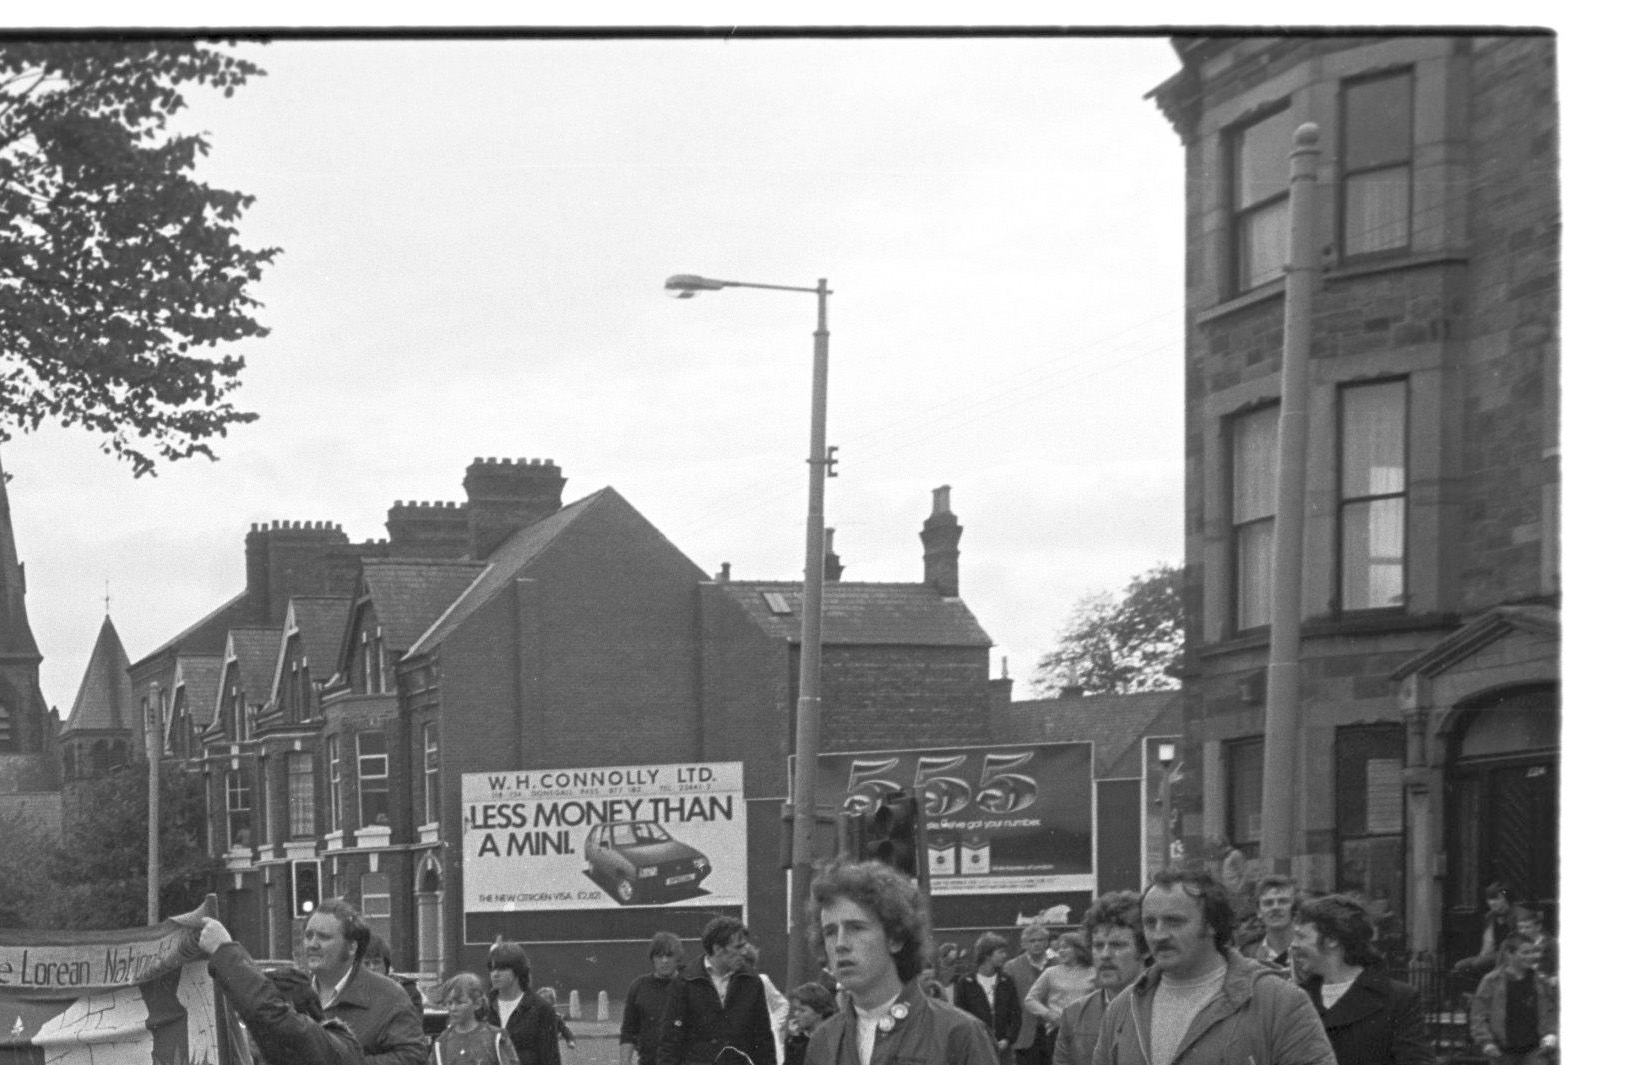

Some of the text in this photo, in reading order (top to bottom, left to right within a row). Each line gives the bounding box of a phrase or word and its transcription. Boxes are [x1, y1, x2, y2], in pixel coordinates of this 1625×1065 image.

[488, 767, 717, 791] W. H. CONNOLLY LTD.
[470, 796, 733, 830] LESS MONEY THAN
[478, 831, 576, 857] A MINI.
[479, 894, 493, 903] THE
[495, 893, 515, 902] NEW
[21, 948, 90, 986] Lorean
